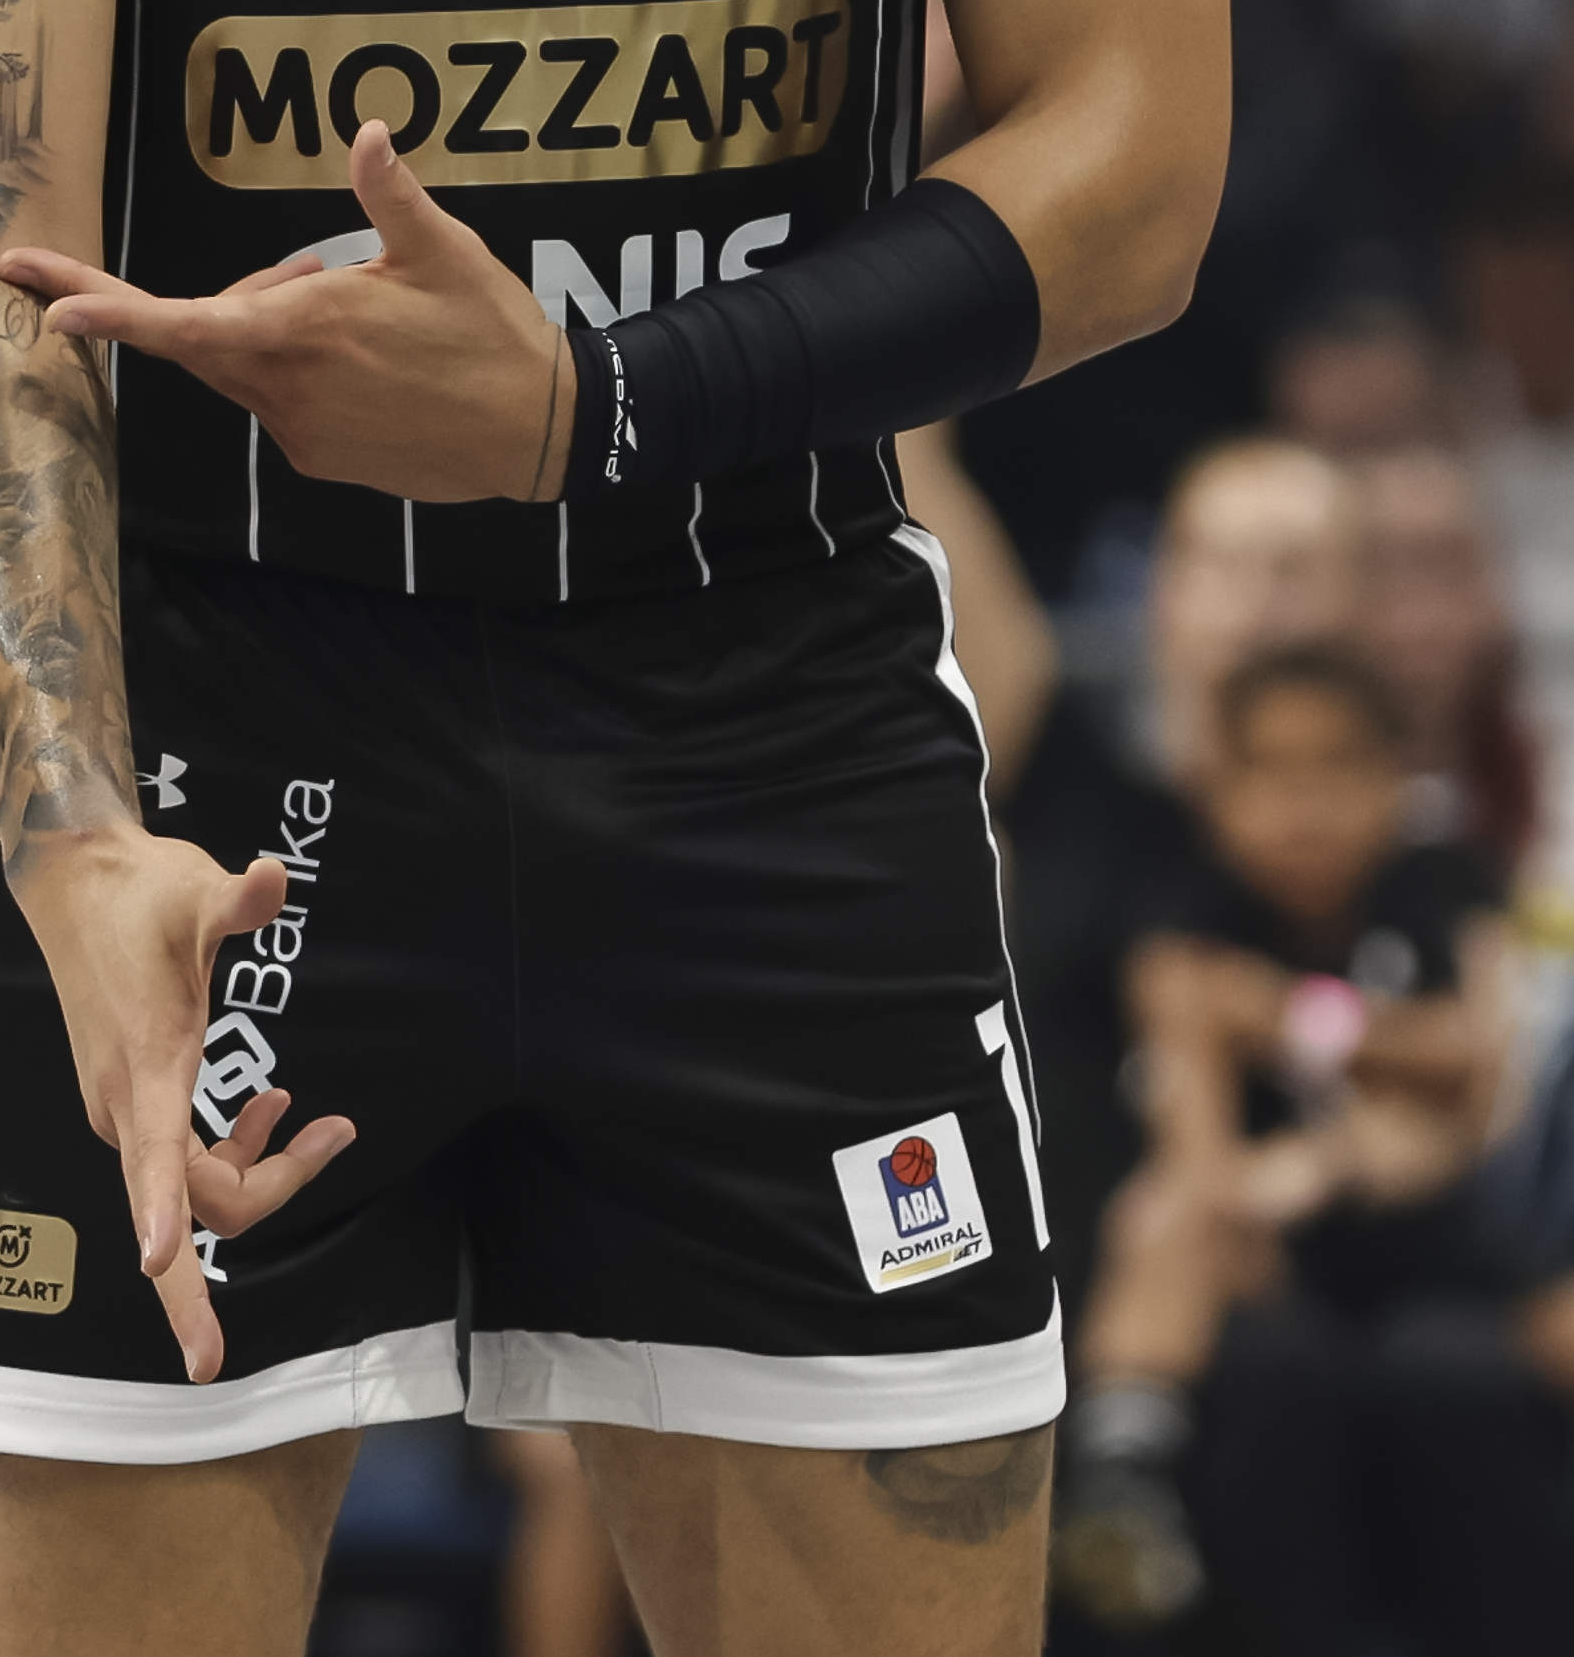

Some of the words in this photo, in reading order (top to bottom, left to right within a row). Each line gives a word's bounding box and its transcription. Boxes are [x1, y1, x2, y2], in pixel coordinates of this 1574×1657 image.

[208, 10, 842, 159] MOZZART
[897, 1186, 945, 1232] ABA
[881, 1222, 982, 1270] ADMIRAL
